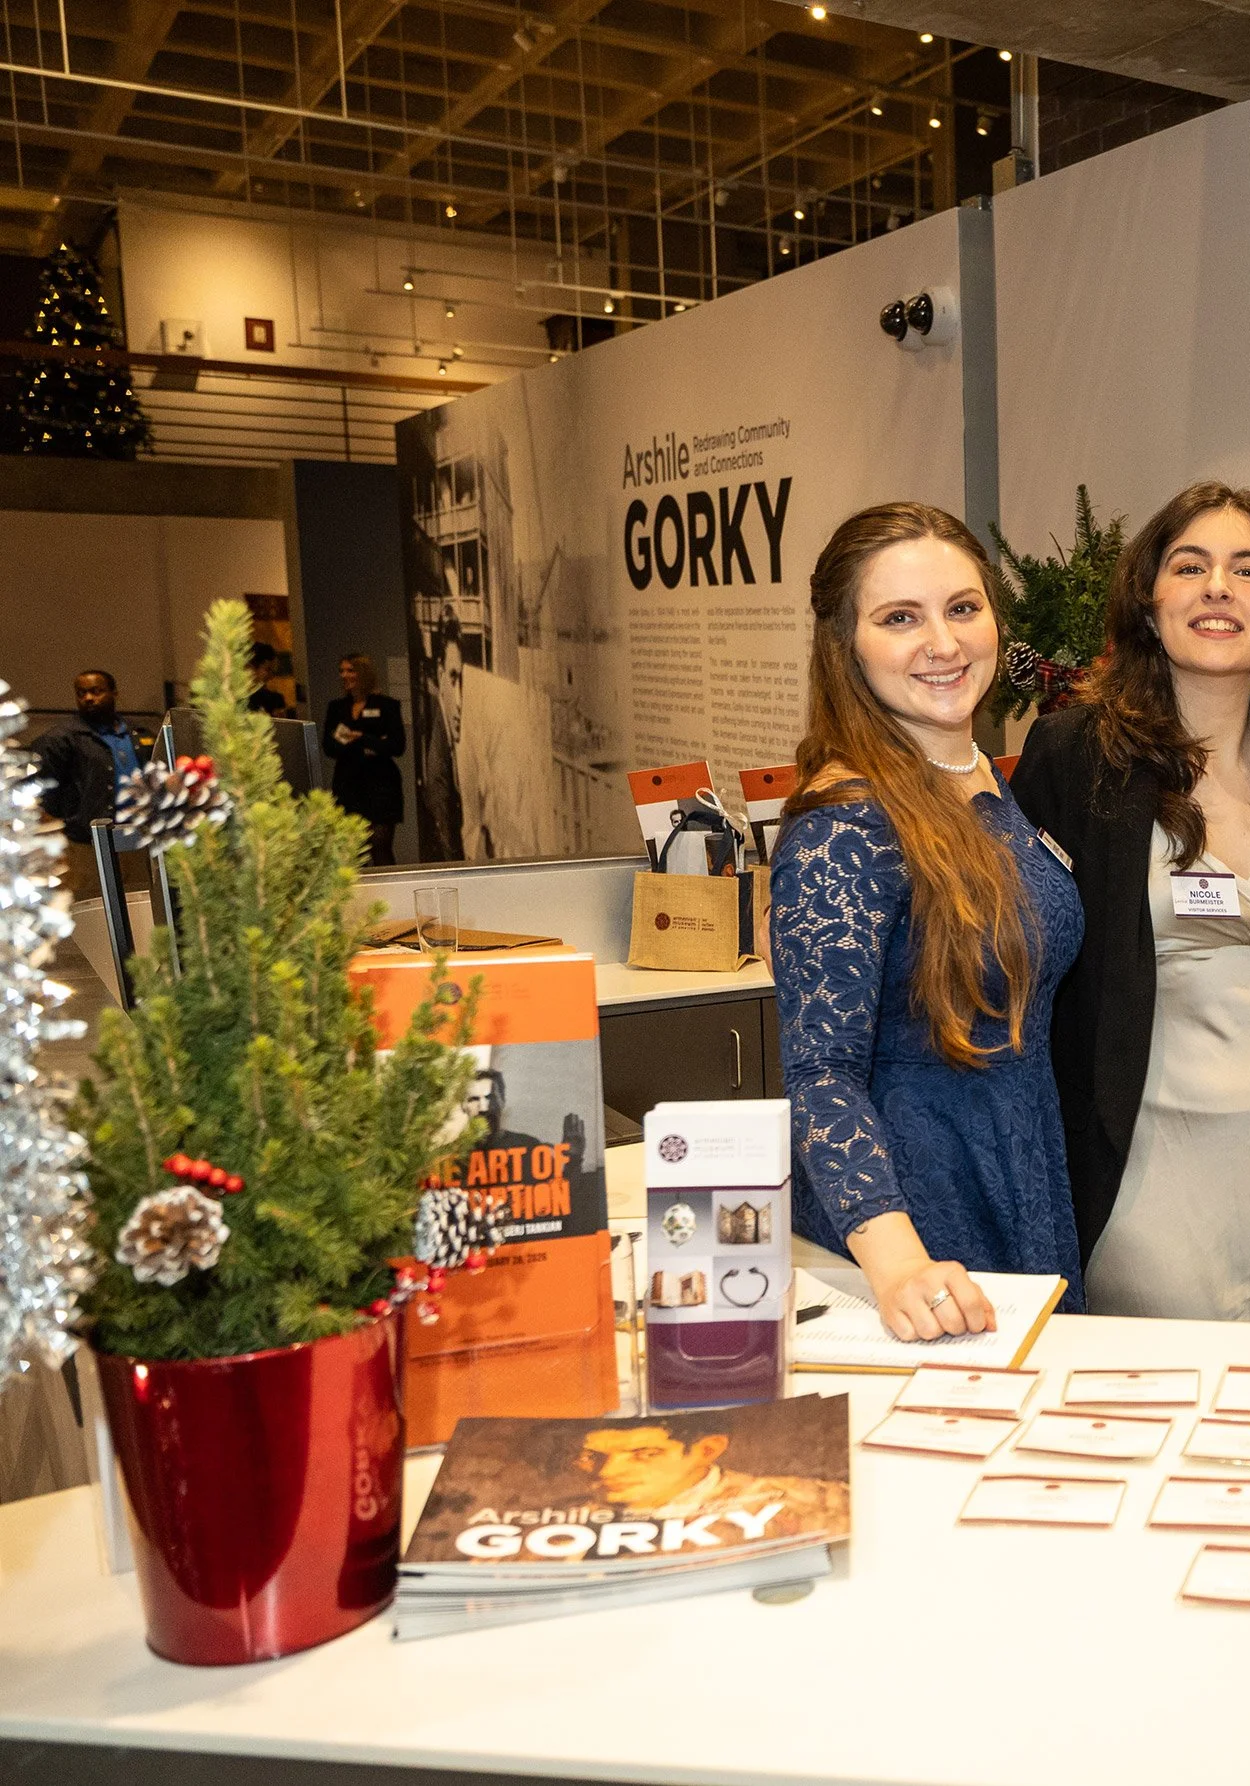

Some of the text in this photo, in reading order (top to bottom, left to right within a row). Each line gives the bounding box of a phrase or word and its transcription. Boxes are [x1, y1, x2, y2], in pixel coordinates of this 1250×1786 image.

[692, 417, 790, 454] Redrawing Community
[622, 432, 690, 490] Arshile
[694, 450, 763, 477] and Connections
[624, 476, 792, 591] GORKY
[1190, 891, 1221, 899] NICOLE
[467, 1147, 527, 1186] ART
[531, 1143, 571, 1181] OF
[455, 1503, 785, 1558] GORKY
[468, 1504, 615, 1525] Arshile
